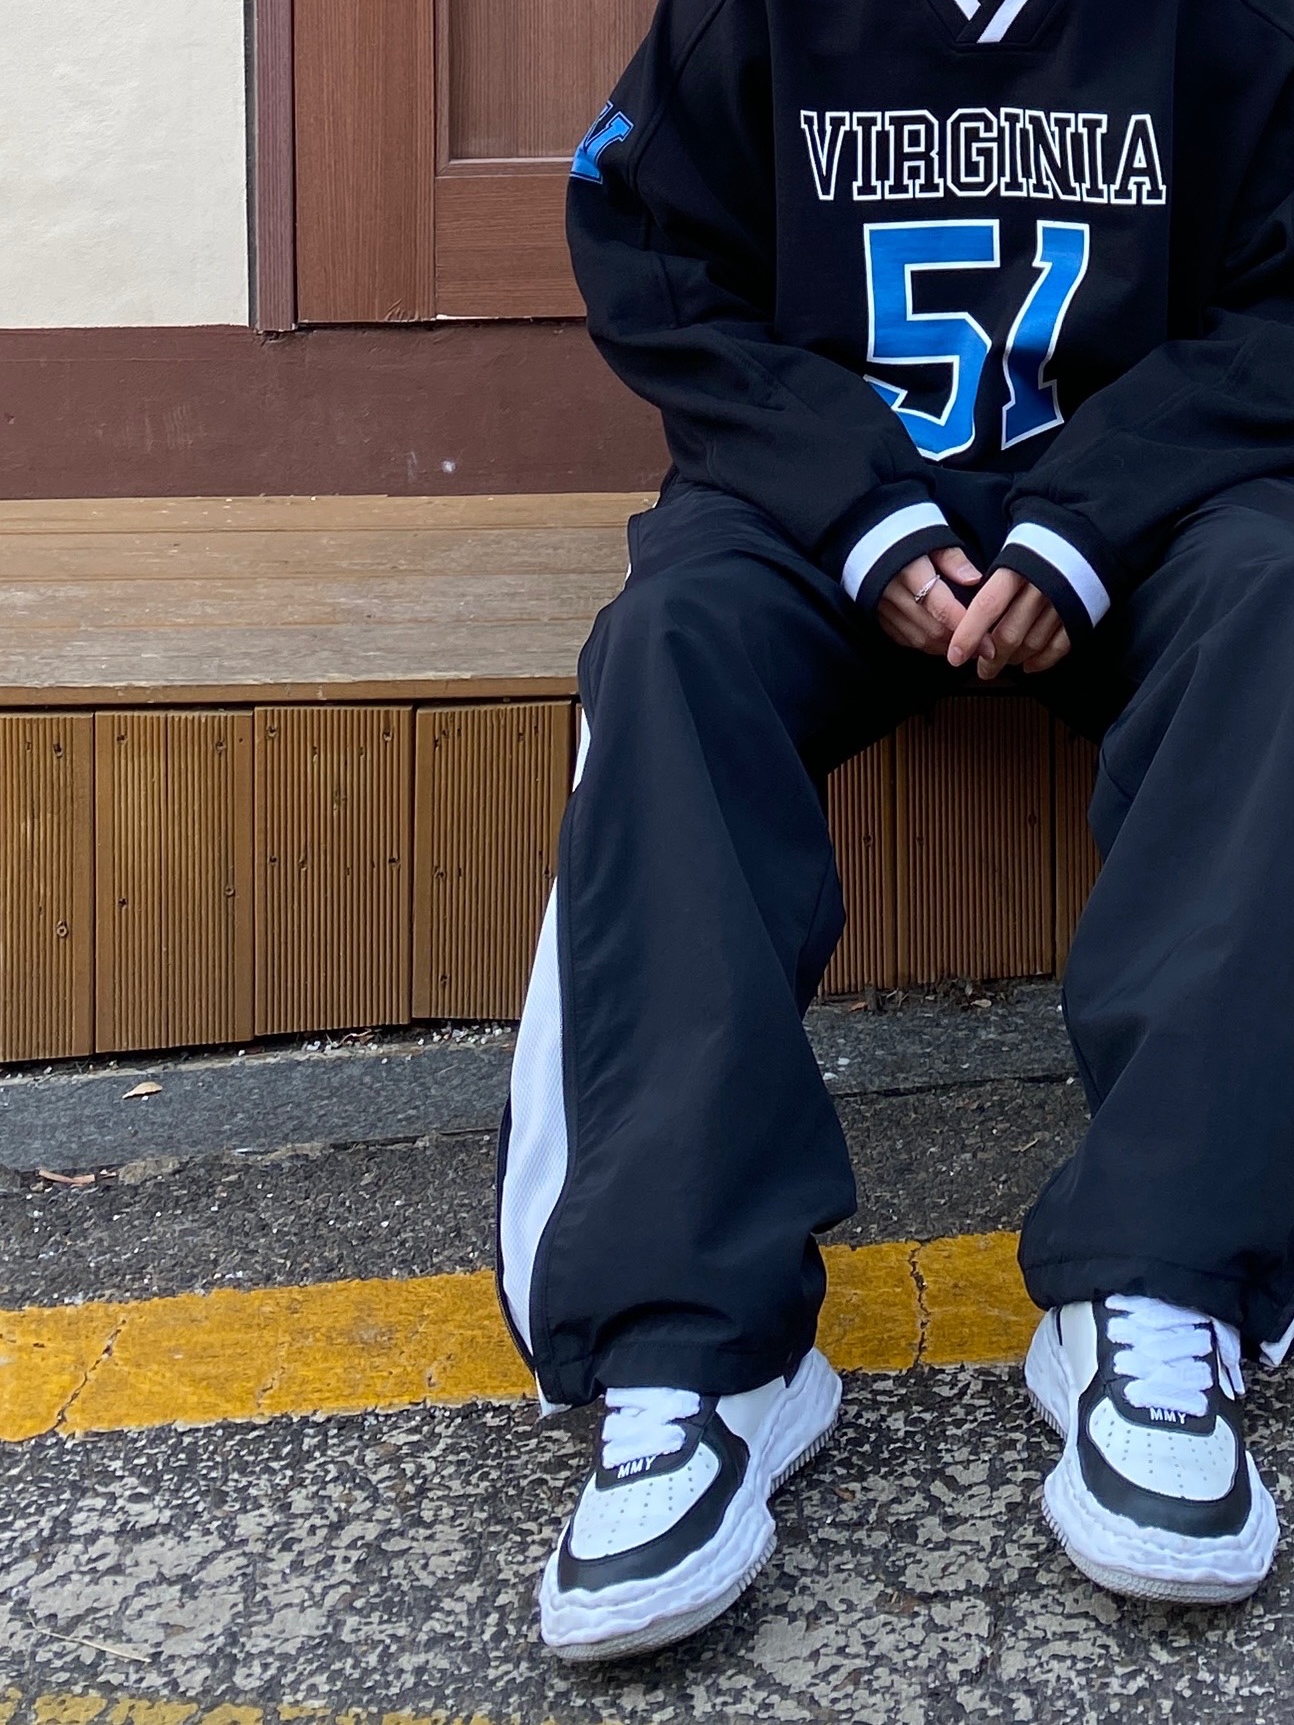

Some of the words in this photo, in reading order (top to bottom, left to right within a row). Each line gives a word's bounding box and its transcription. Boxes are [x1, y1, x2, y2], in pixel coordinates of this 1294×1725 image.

[800, 107, 1167, 205] VIRGINIA
[862, 219, 1091, 462] 51
[1150, 1407, 1186, 1424] MMY
[617, 1455, 657, 1479] MMY
